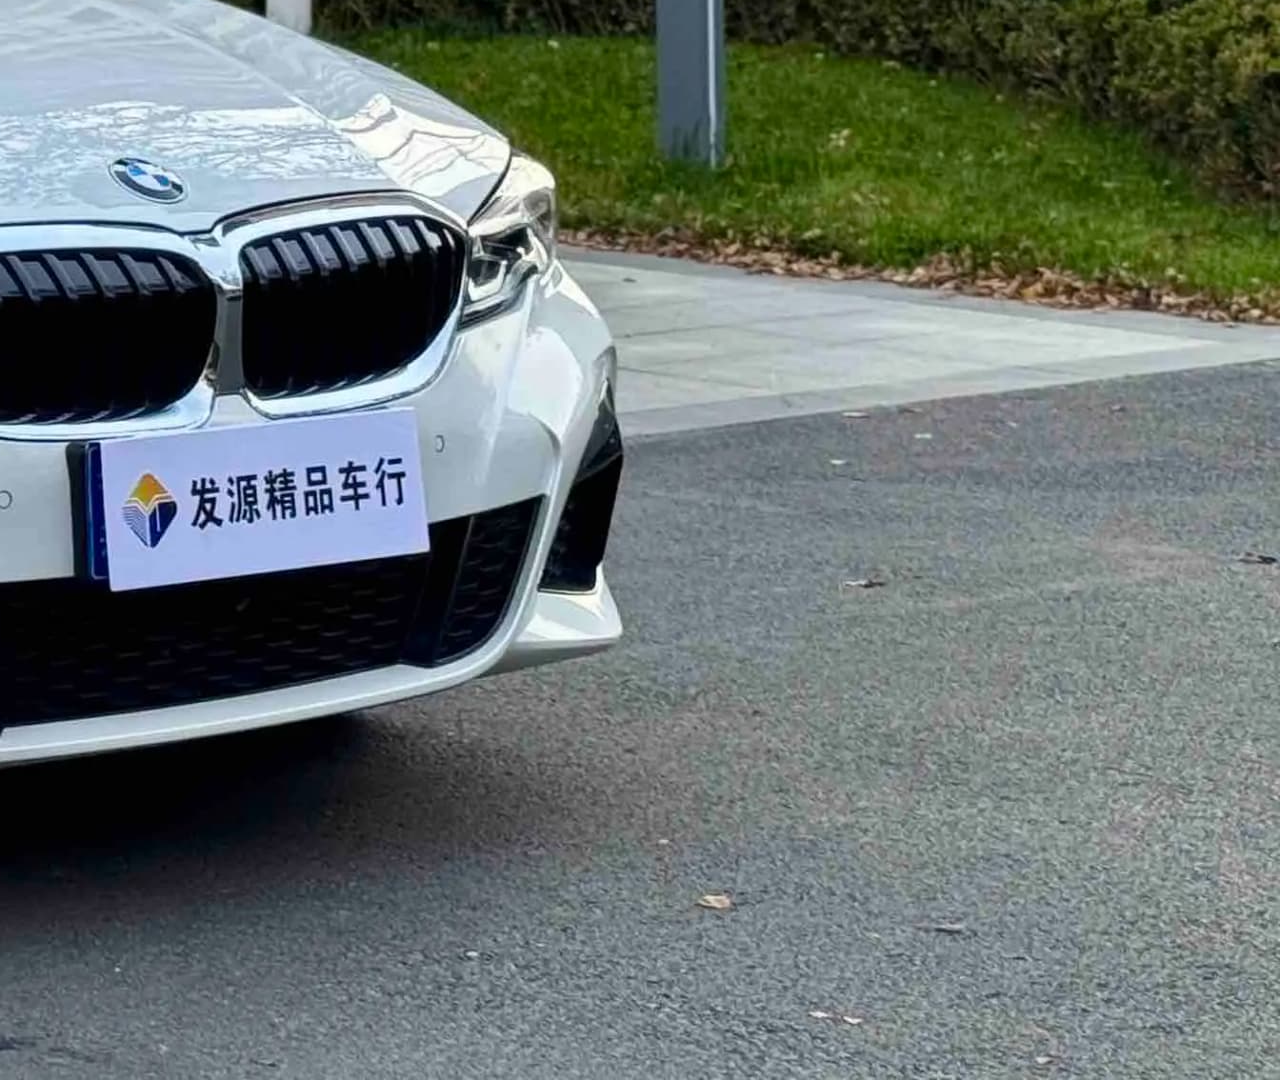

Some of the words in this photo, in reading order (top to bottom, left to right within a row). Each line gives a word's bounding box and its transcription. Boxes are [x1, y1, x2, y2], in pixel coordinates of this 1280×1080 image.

[190, 457, 407, 530] 发源精品车行
